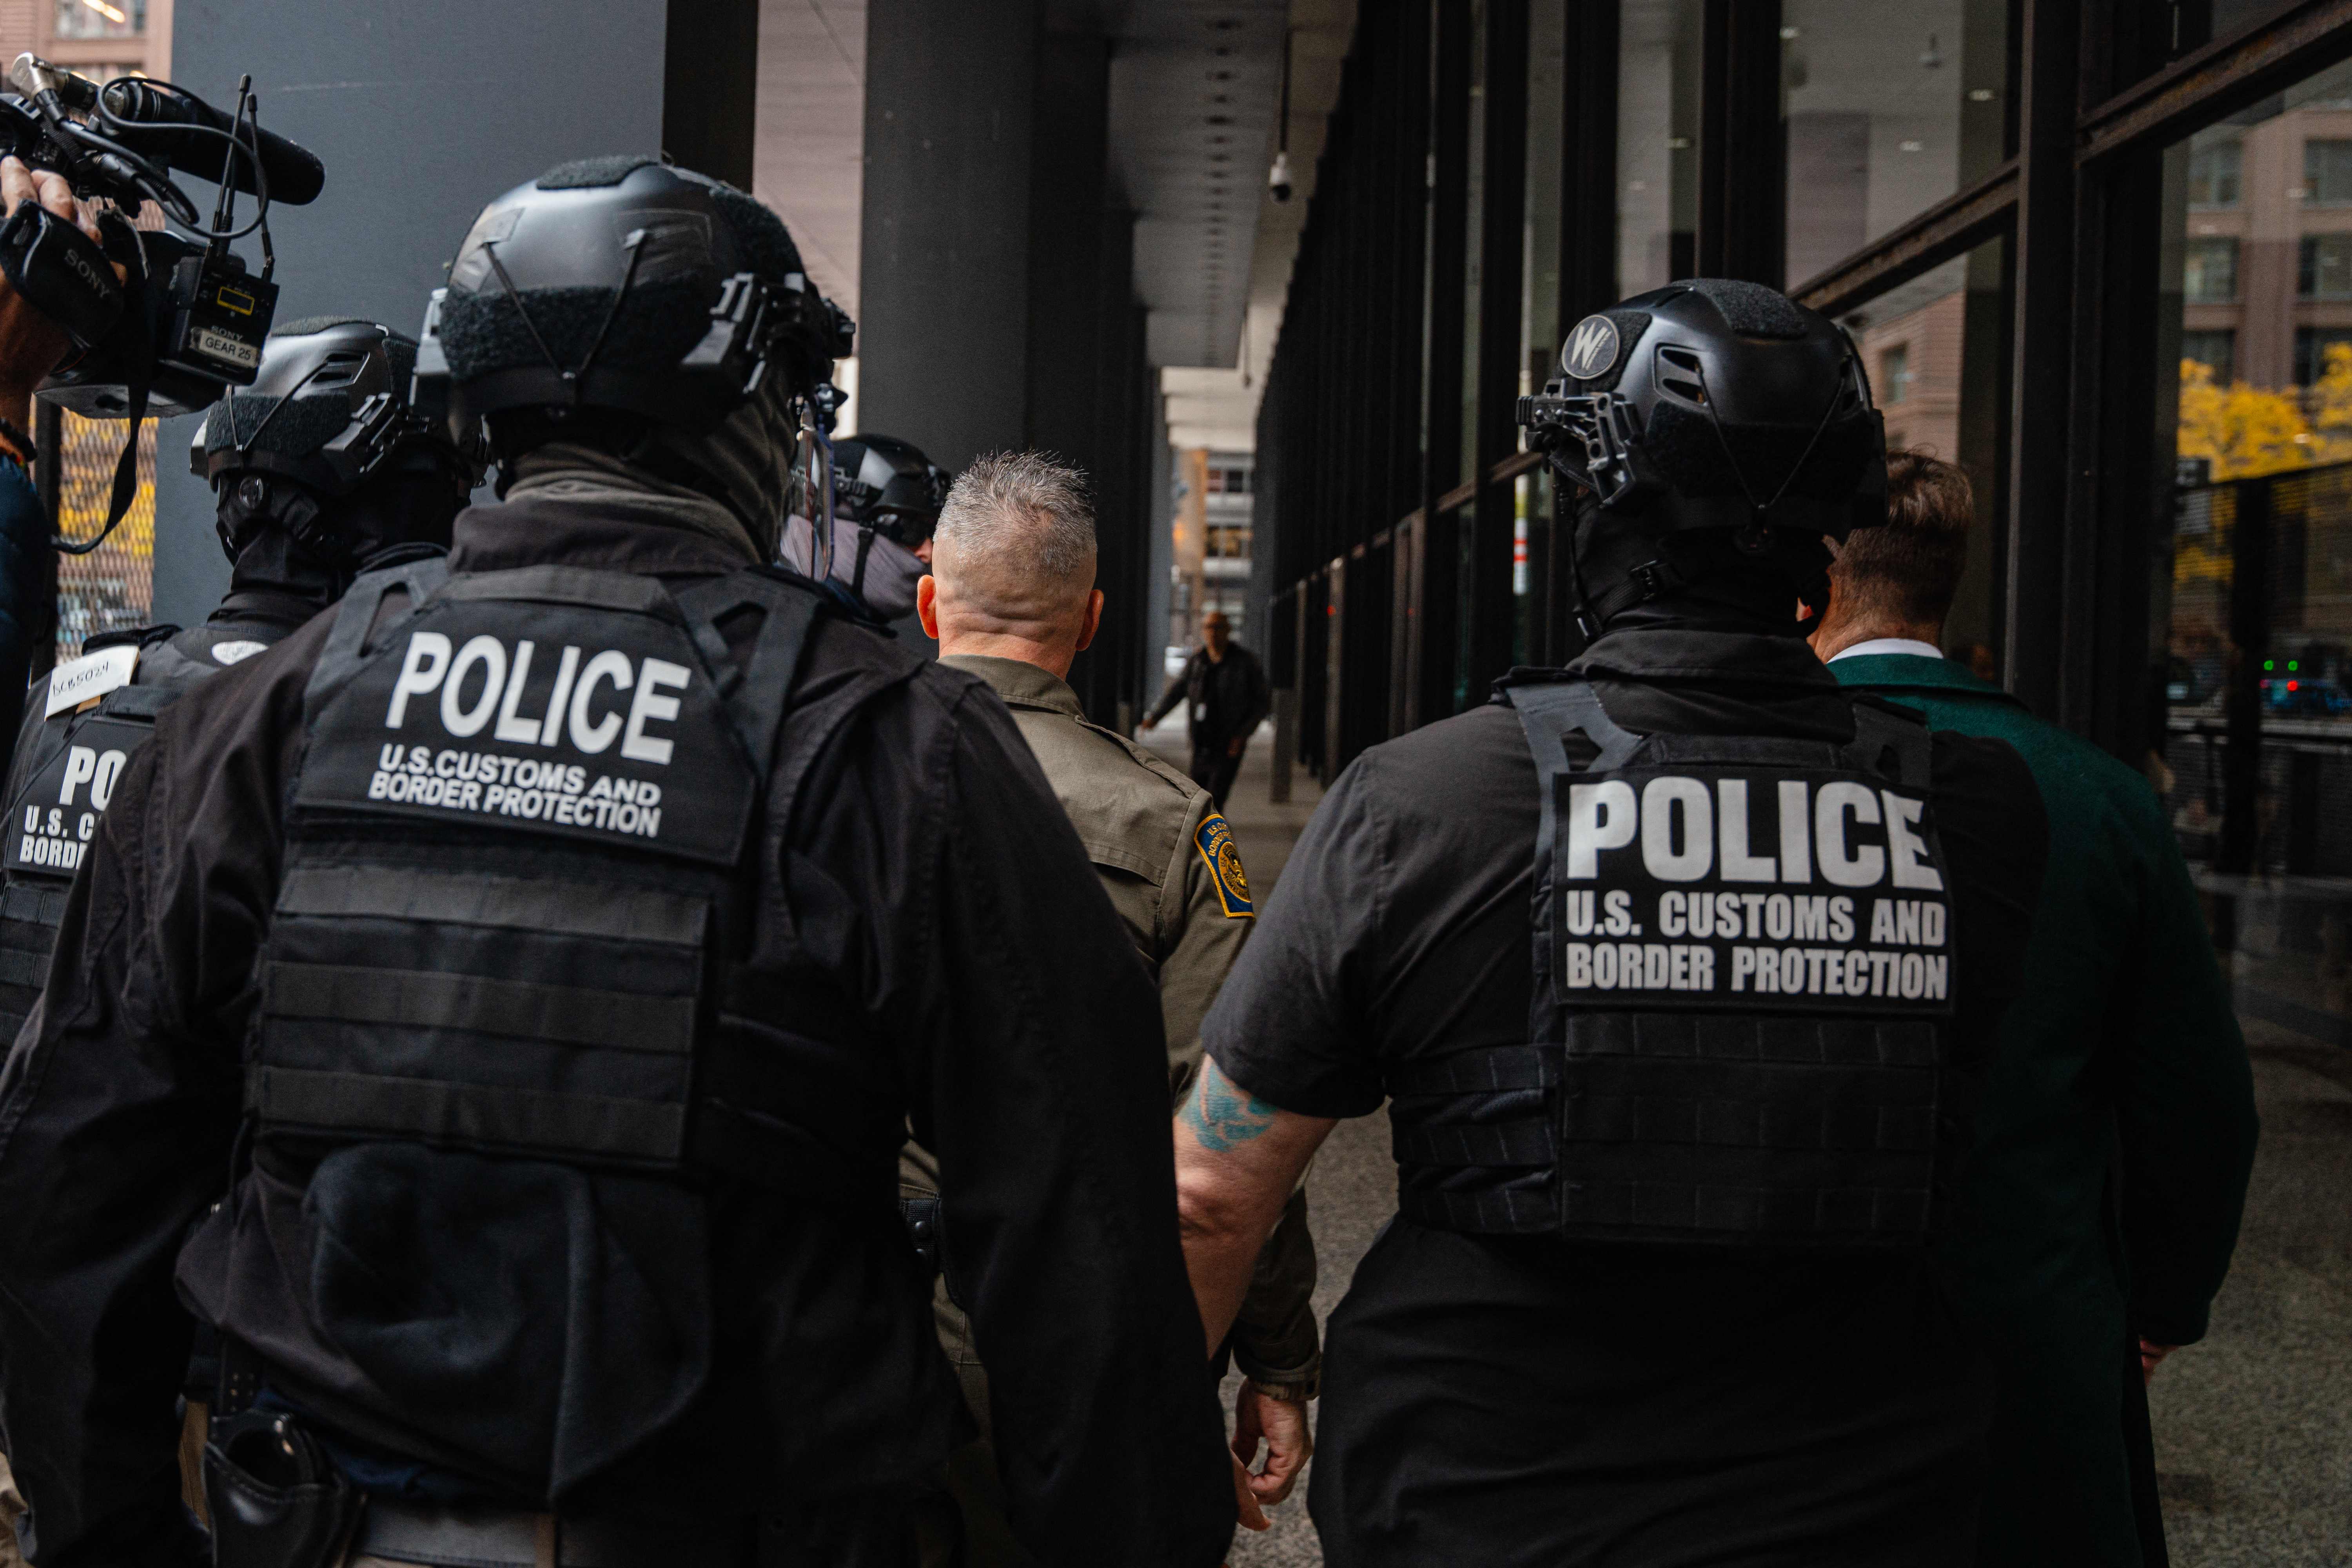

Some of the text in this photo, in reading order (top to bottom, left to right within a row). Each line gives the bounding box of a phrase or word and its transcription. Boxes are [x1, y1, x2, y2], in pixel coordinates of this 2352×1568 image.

[64, 249, 110, 298] SONY
[206, 337, 251, 360] GEAR 25
[386, 632, 691, 765] POLICE
[368, 771, 661, 838] BORDER PROTECTION
[589, 777, 661, 807] AND
[25, 805, 68, 838] U.S.
[1567, 776, 1944, 891] POLICE
[1567, 890, 1945, 946] U.S. CUSTOMS AND
[1567, 943, 1947, 999] BORDER PROTECTION
